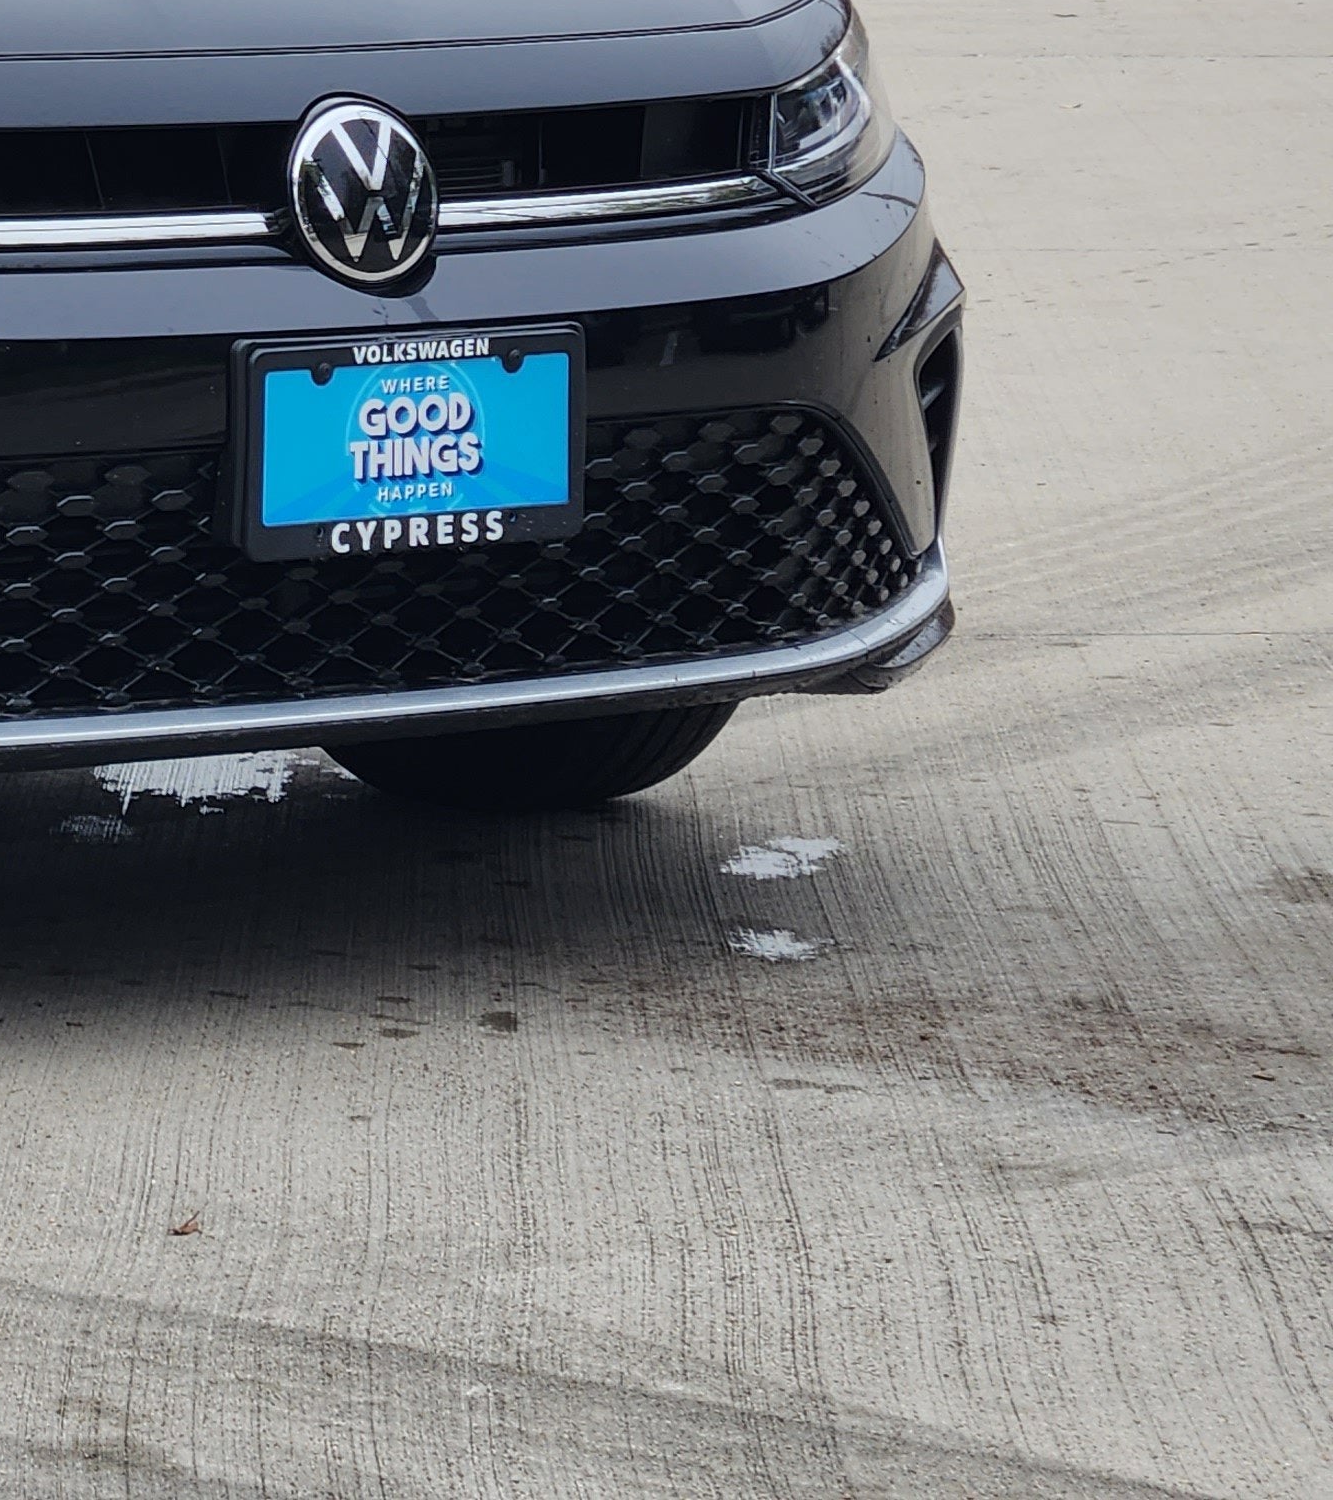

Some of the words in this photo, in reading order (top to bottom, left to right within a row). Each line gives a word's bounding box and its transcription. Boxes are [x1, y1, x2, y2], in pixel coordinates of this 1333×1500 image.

[352, 337, 491, 365] VOLKSWAGEN
[380, 375, 451, 394] WHERE
[358, 392, 473, 437] GOOD
[349, 431, 482, 480] THINGS
[377, 482, 454, 503] HAPPEN
[330, 510, 505, 554] CYPRESS
